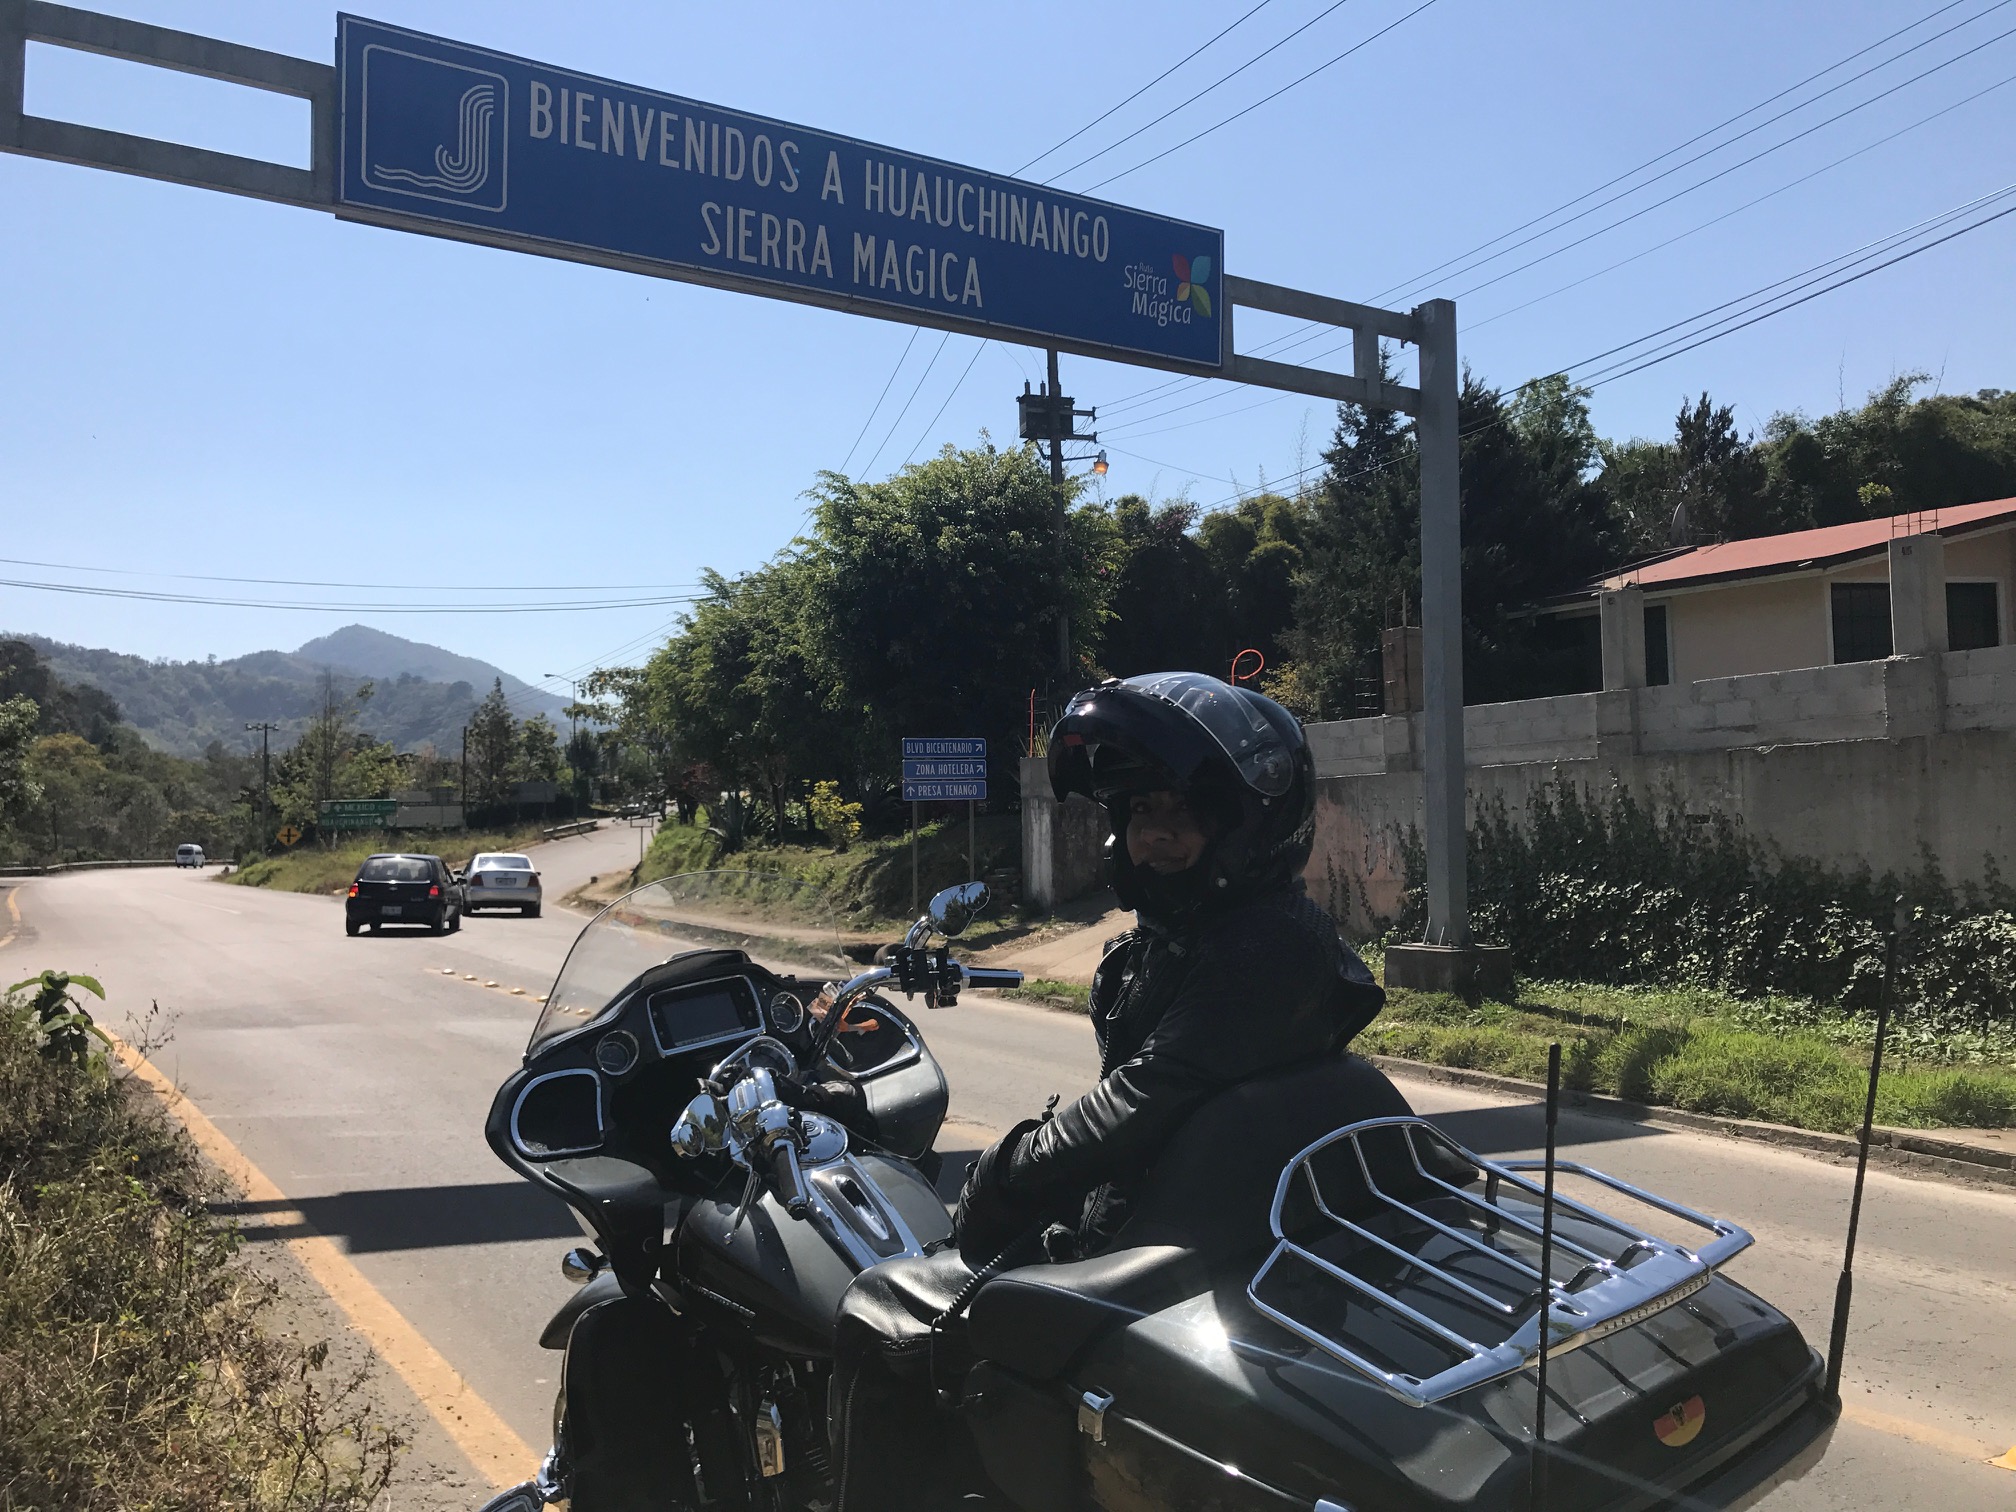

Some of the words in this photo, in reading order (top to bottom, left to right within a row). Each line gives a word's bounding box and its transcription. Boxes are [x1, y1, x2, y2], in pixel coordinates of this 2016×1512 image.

[529, 80, 800, 193] BIENVENIDOS
[820, 150, 845, 205] A
[864, 158, 1110, 263] HUAUCHINANGO
[700, 201, 834, 279] SIERRA
[852, 231, 983, 308] MAGICA
[1123, 265, 1167, 296] Sierra
[1132, 291, 1192, 327] Mágica
[926, 742, 973, 754] BICENTENARIO
[916, 764, 935, 775] ZONA
[938, 763, 975, 775] HOTELERA
[918, 785, 942, 796] PRESA
[945, 784, 978, 796] TENANGO
